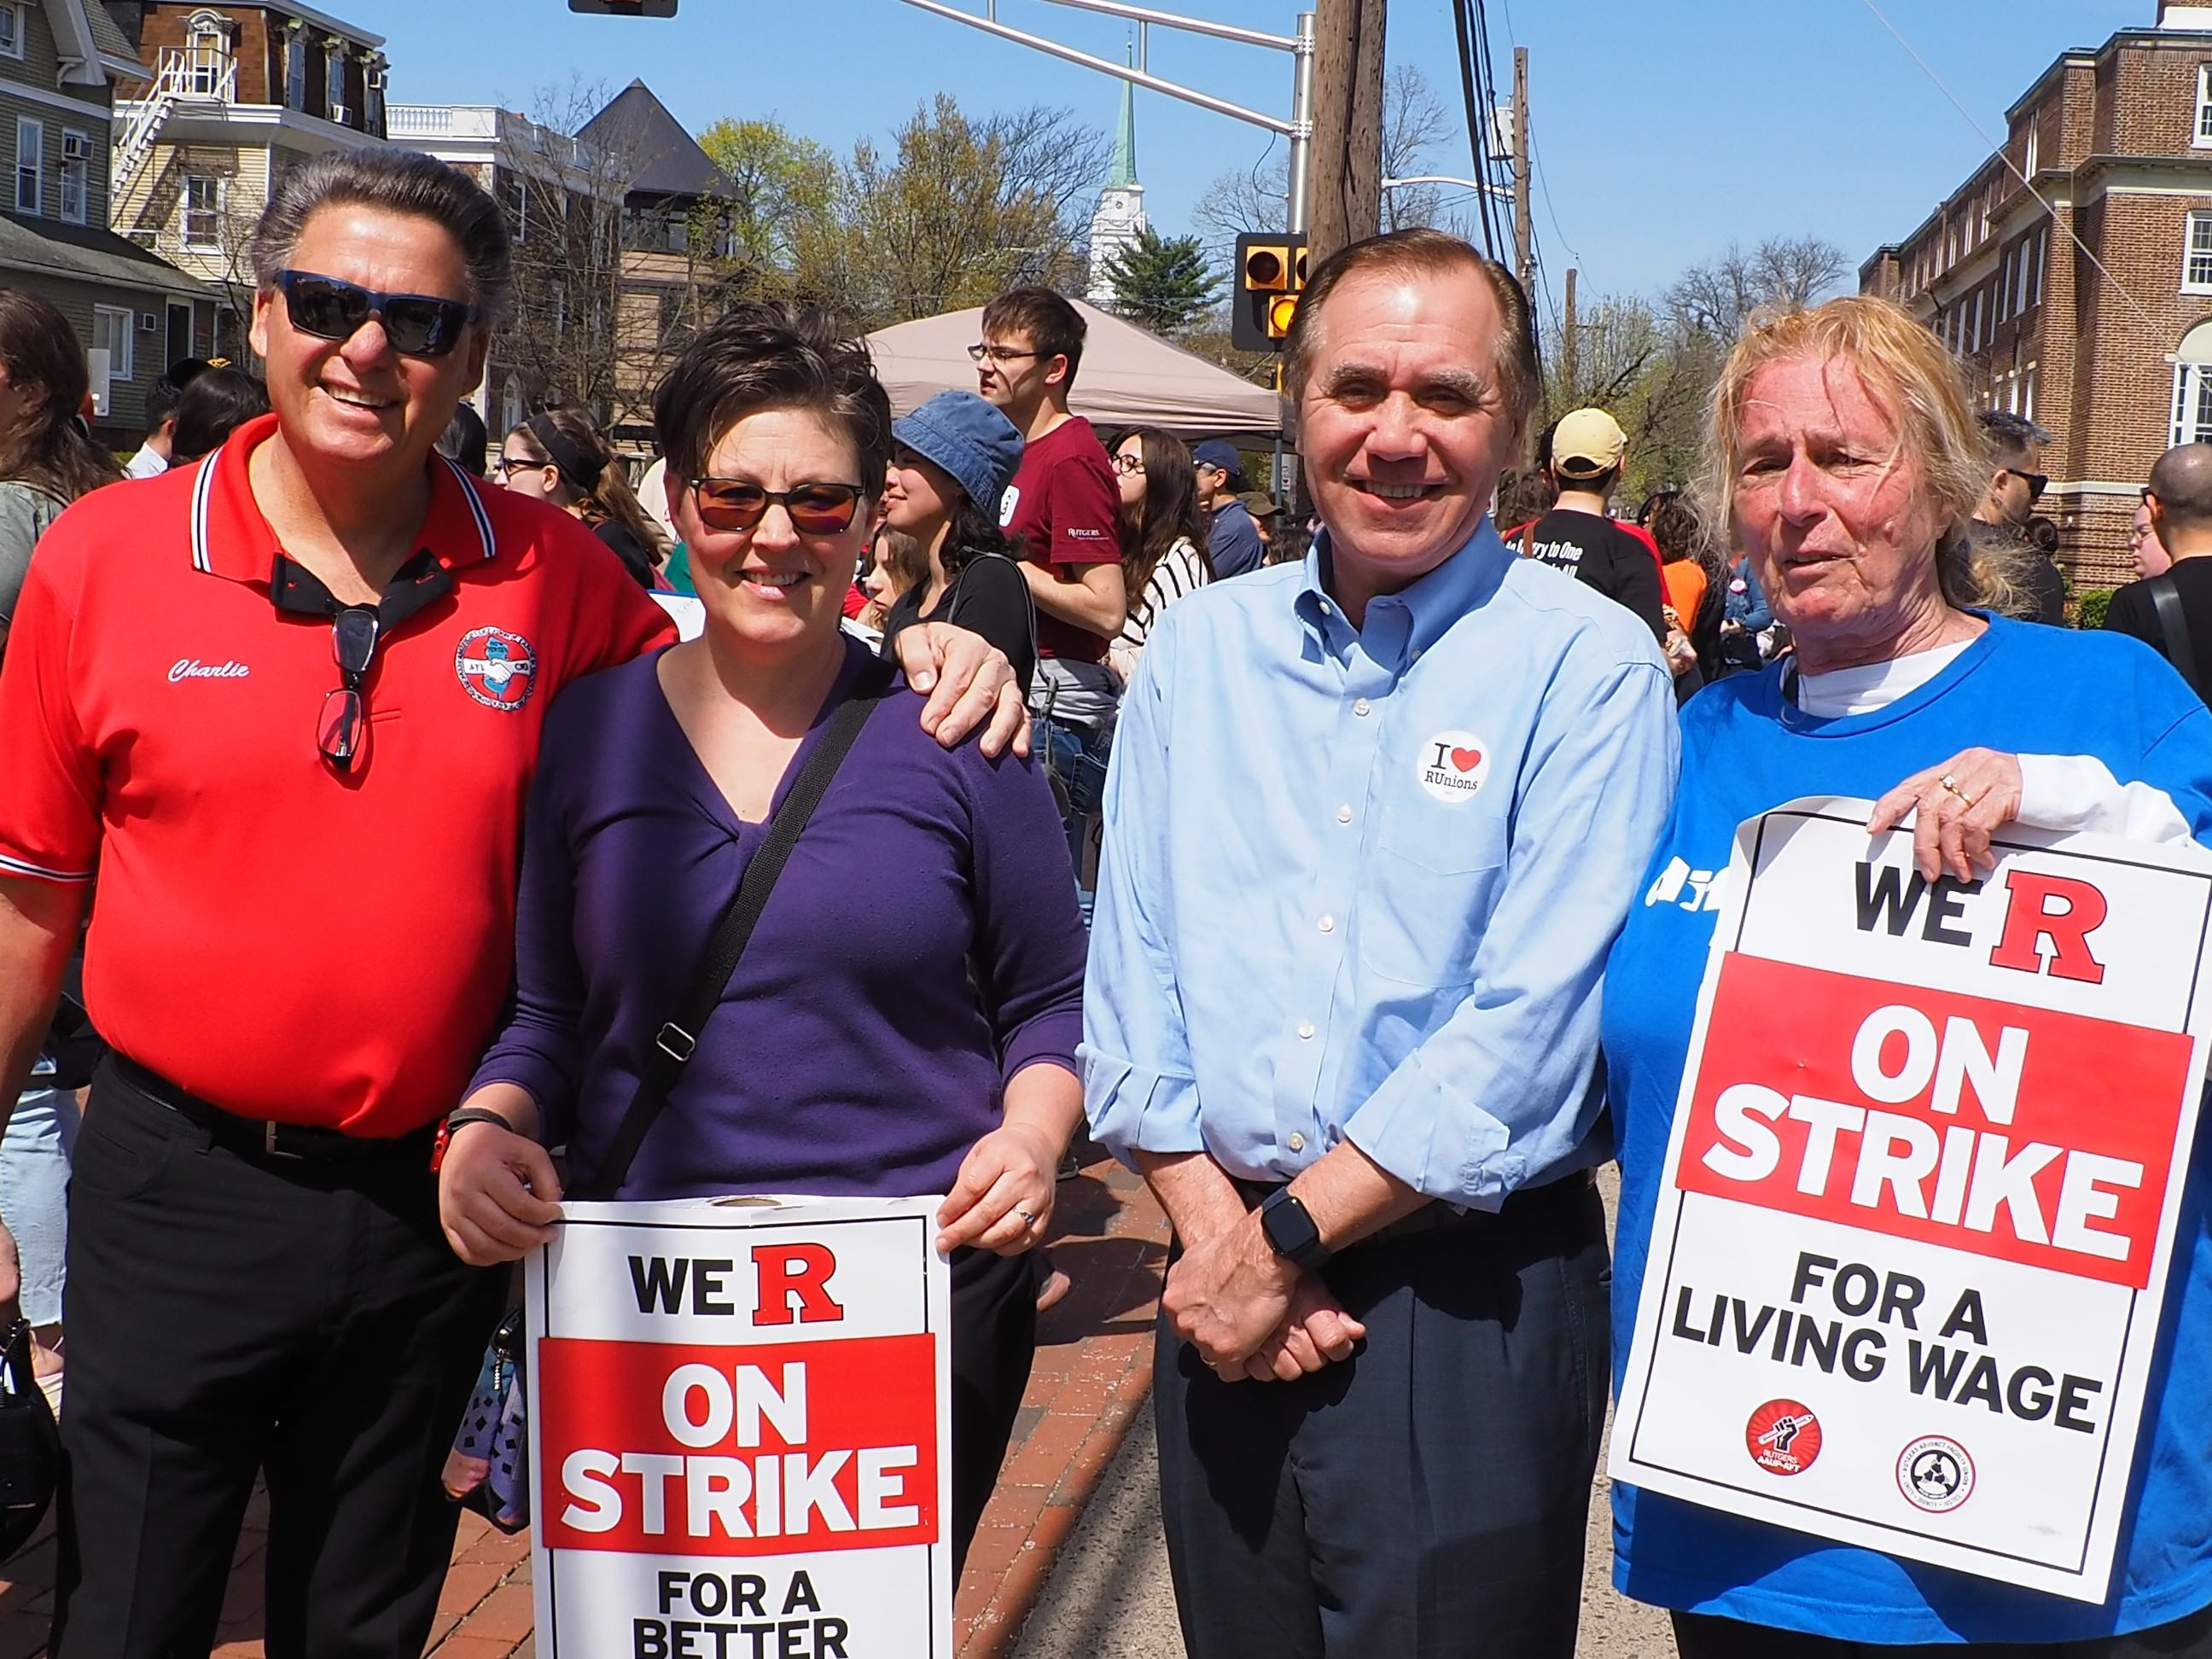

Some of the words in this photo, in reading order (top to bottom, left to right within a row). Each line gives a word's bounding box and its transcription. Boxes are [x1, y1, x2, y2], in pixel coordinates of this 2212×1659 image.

[1547, 540, 1562, 558] to
[1559, 541, 1583, 561] One
[167, 658, 250, 683] Charlie
[1424, 770, 1478, 790] RUnions
[1430, 742, 1451, 770] I
[1855, 861, 1984, 948] WE
[1989, 869, 2108, 986] R
[1851, 1004, 2030, 1126] ON
[1701, 1083, 2145, 1262] STRIKE
[627, 1254, 735, 1316] WE
[751, 1243, 844, 1326] R
[1790, 1251, 1926, 1331] FOR
[1938, 1288, 1989, 1347] A
[1671, 1285, 1888, 1383] LIVING
[1907, 1337, 2104, 1435] WAGE
[661, 1361, 807, 1448] ON
[560, 1444, 920, 1539] STRIKE
[658, 1570, 767, 1617] FOR
[780, 1569, 822, 1612] A
[633, 1617, 849, 1659] BETTER
